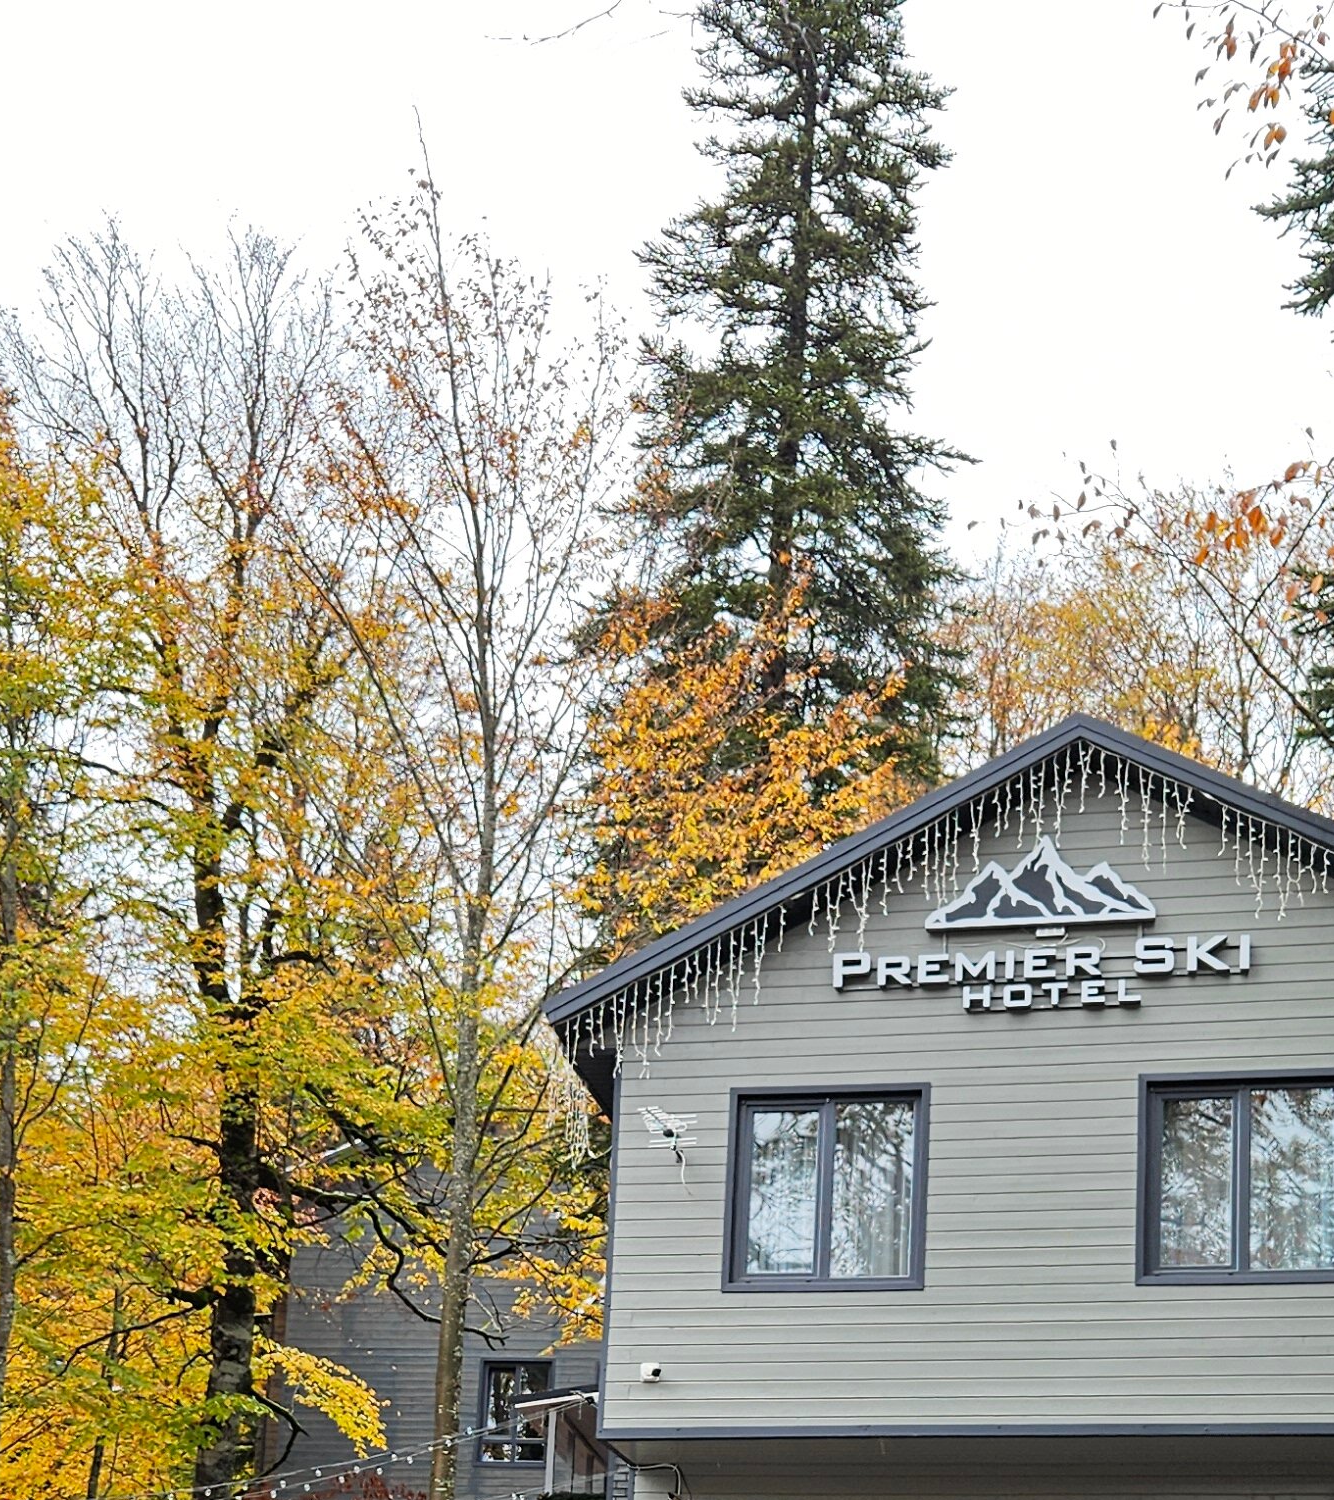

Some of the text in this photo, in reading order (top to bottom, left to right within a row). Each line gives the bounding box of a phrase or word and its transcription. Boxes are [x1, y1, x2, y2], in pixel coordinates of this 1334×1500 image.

[832, 934, 1253, 990] PREMIER SKI
[961, 979, 1142, 1009] HOTEL
